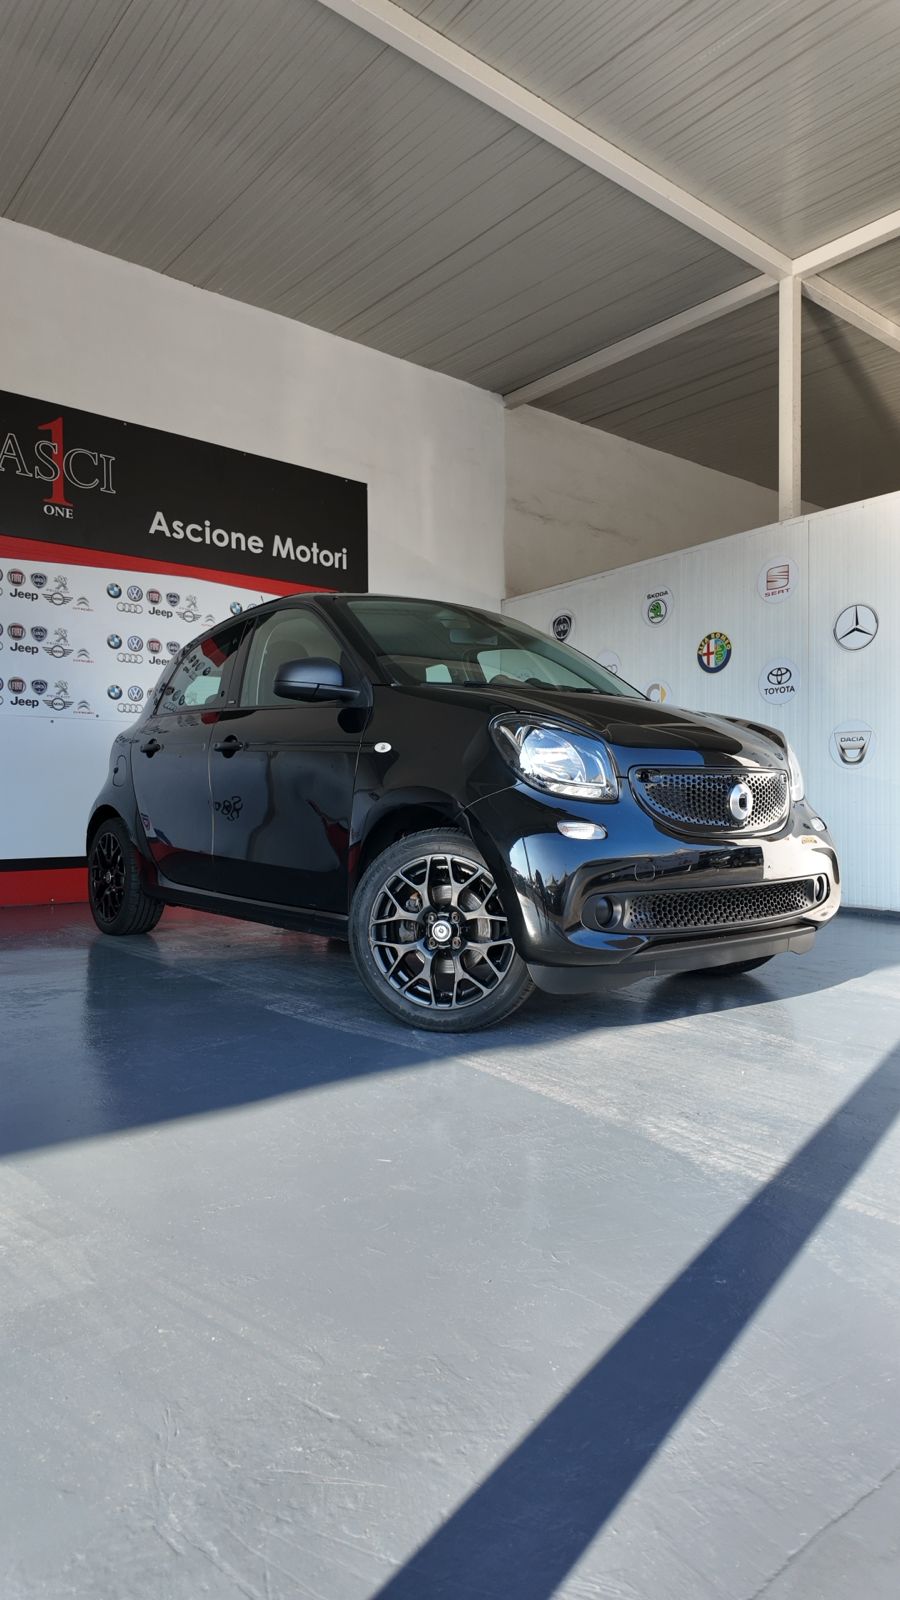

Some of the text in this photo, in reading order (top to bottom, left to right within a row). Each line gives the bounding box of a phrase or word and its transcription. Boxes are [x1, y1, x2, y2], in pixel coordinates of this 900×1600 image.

[43, 504, 74, 519] ONE
[148, 511, 348, 570] Ascione Motori
[9, 588, 39, 602] Jeep
[764, 587, 791, 598] SEAT
[148, 606, 173, 618] Jeep
[9, 642, 39, 655] Jeep
[148, 656, 170, 666] Jee
[764, 685, 796, 696] TOYOTA
[10, 696, 39, 708] Jeep
